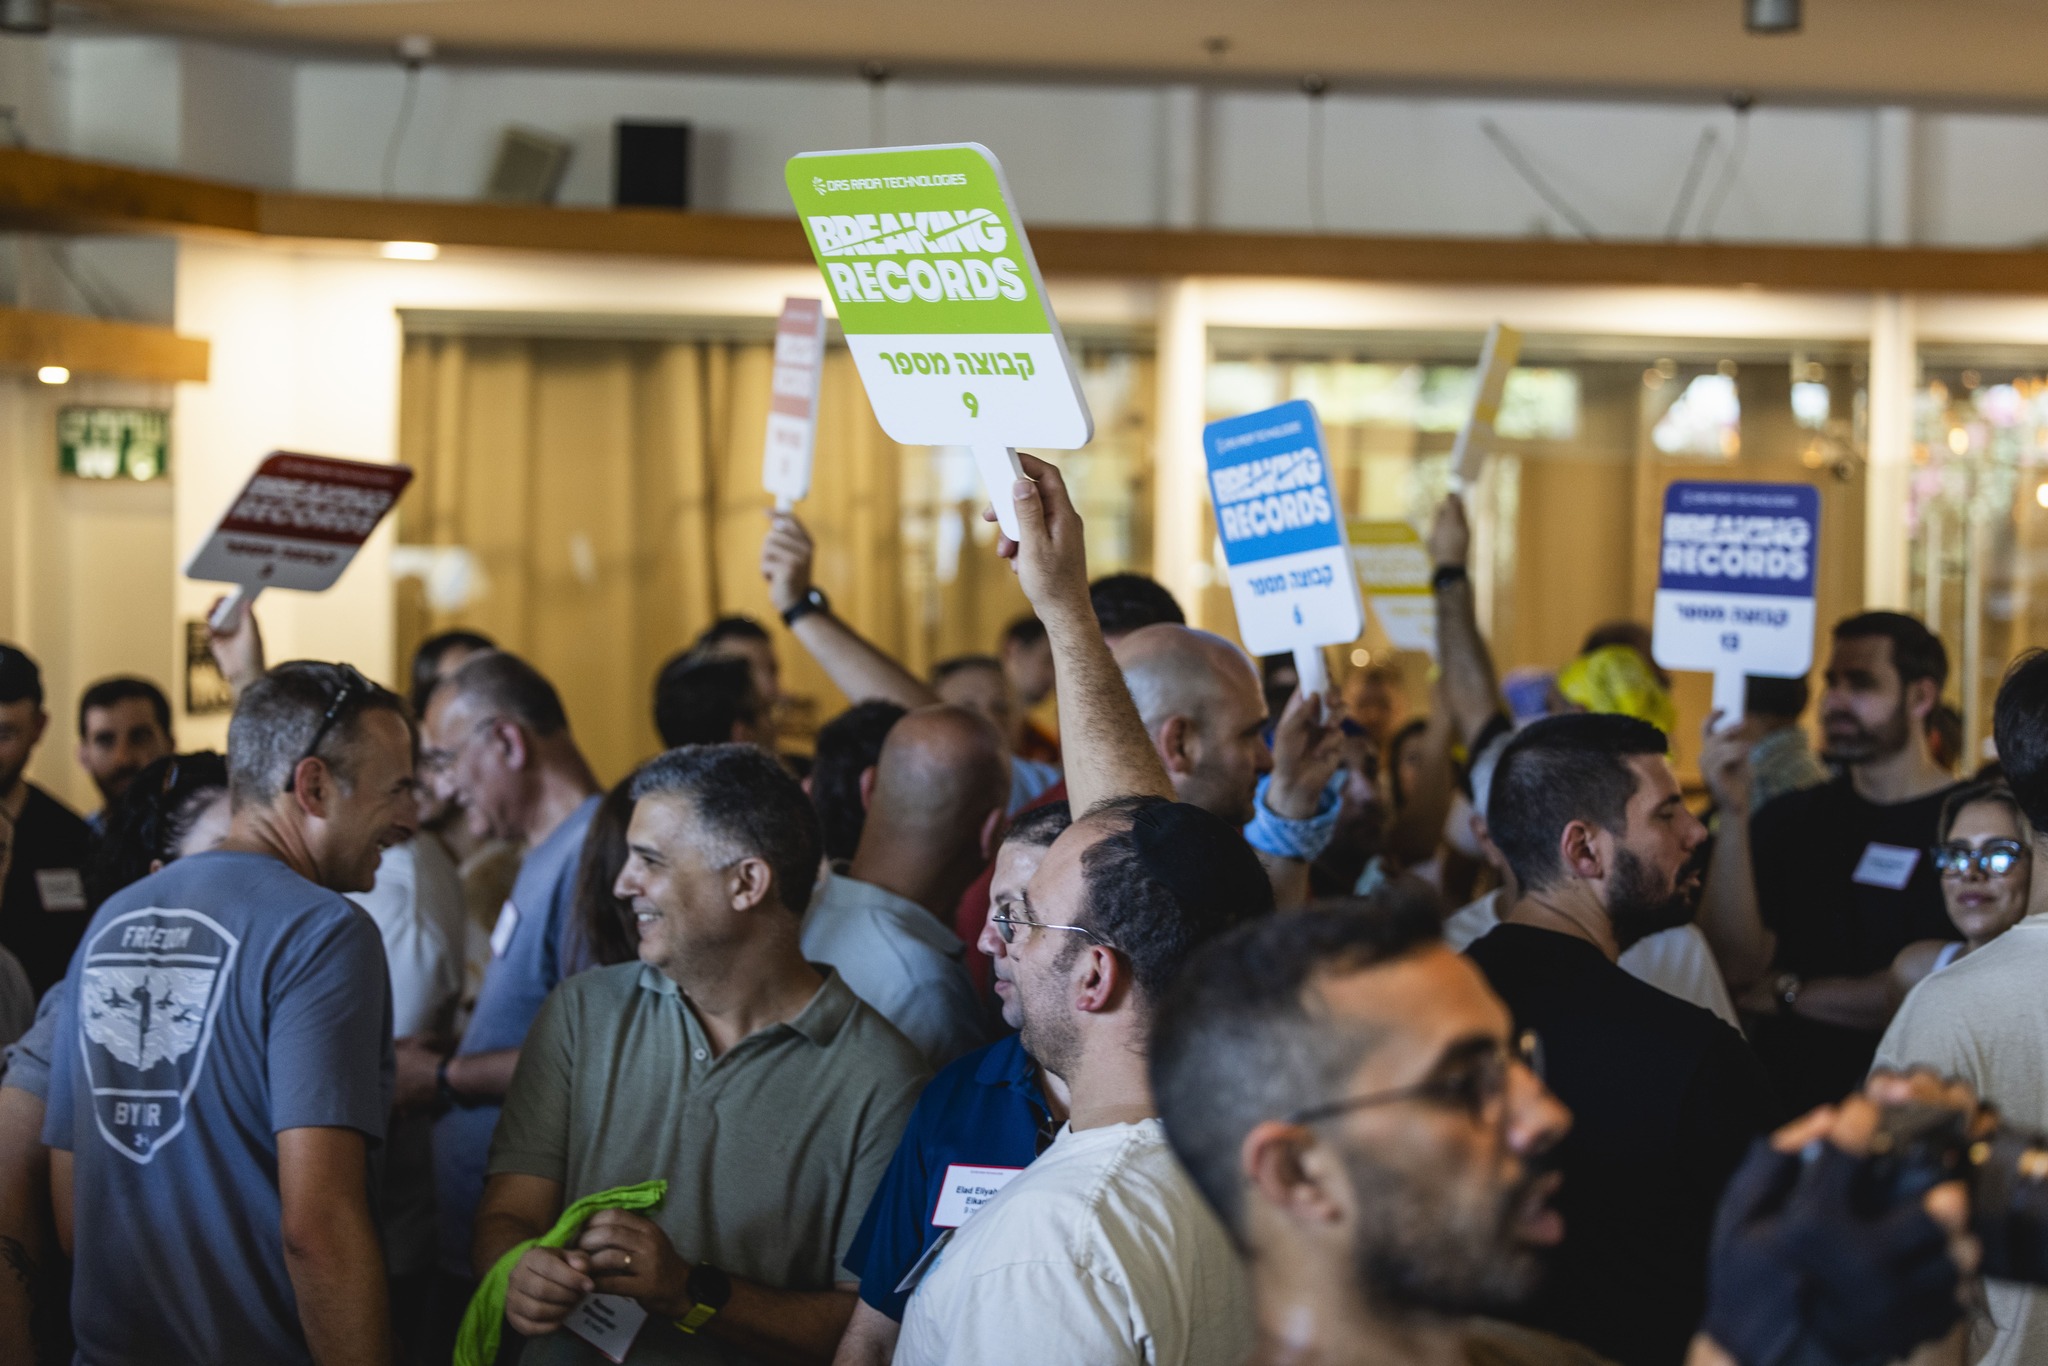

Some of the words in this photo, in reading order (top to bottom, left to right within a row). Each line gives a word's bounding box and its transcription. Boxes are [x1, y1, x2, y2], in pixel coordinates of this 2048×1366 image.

[826, 176, 850, 191] DRS
[851, 175, 883, 190] RADA
[883, 173, 967, 189] TECHNOLOGIES
[807, 208, 1007, 256] BREAKING
[826, 257, 1028, 303] RECORDS
[879, 352, 950, 375] מספר
[953, 352, 1035, 380] קבוצה
[962, 392, 979, 418] 9
[1211, 447, 1322, 505] BREAKING
[1221, 485, 1332, 542] RECORDS
[1662, 546, 1809, 580] RECORDS
[956, 1186, 973, 1194] Elad
[975, 1186, 1000, 1197] Eliyah
